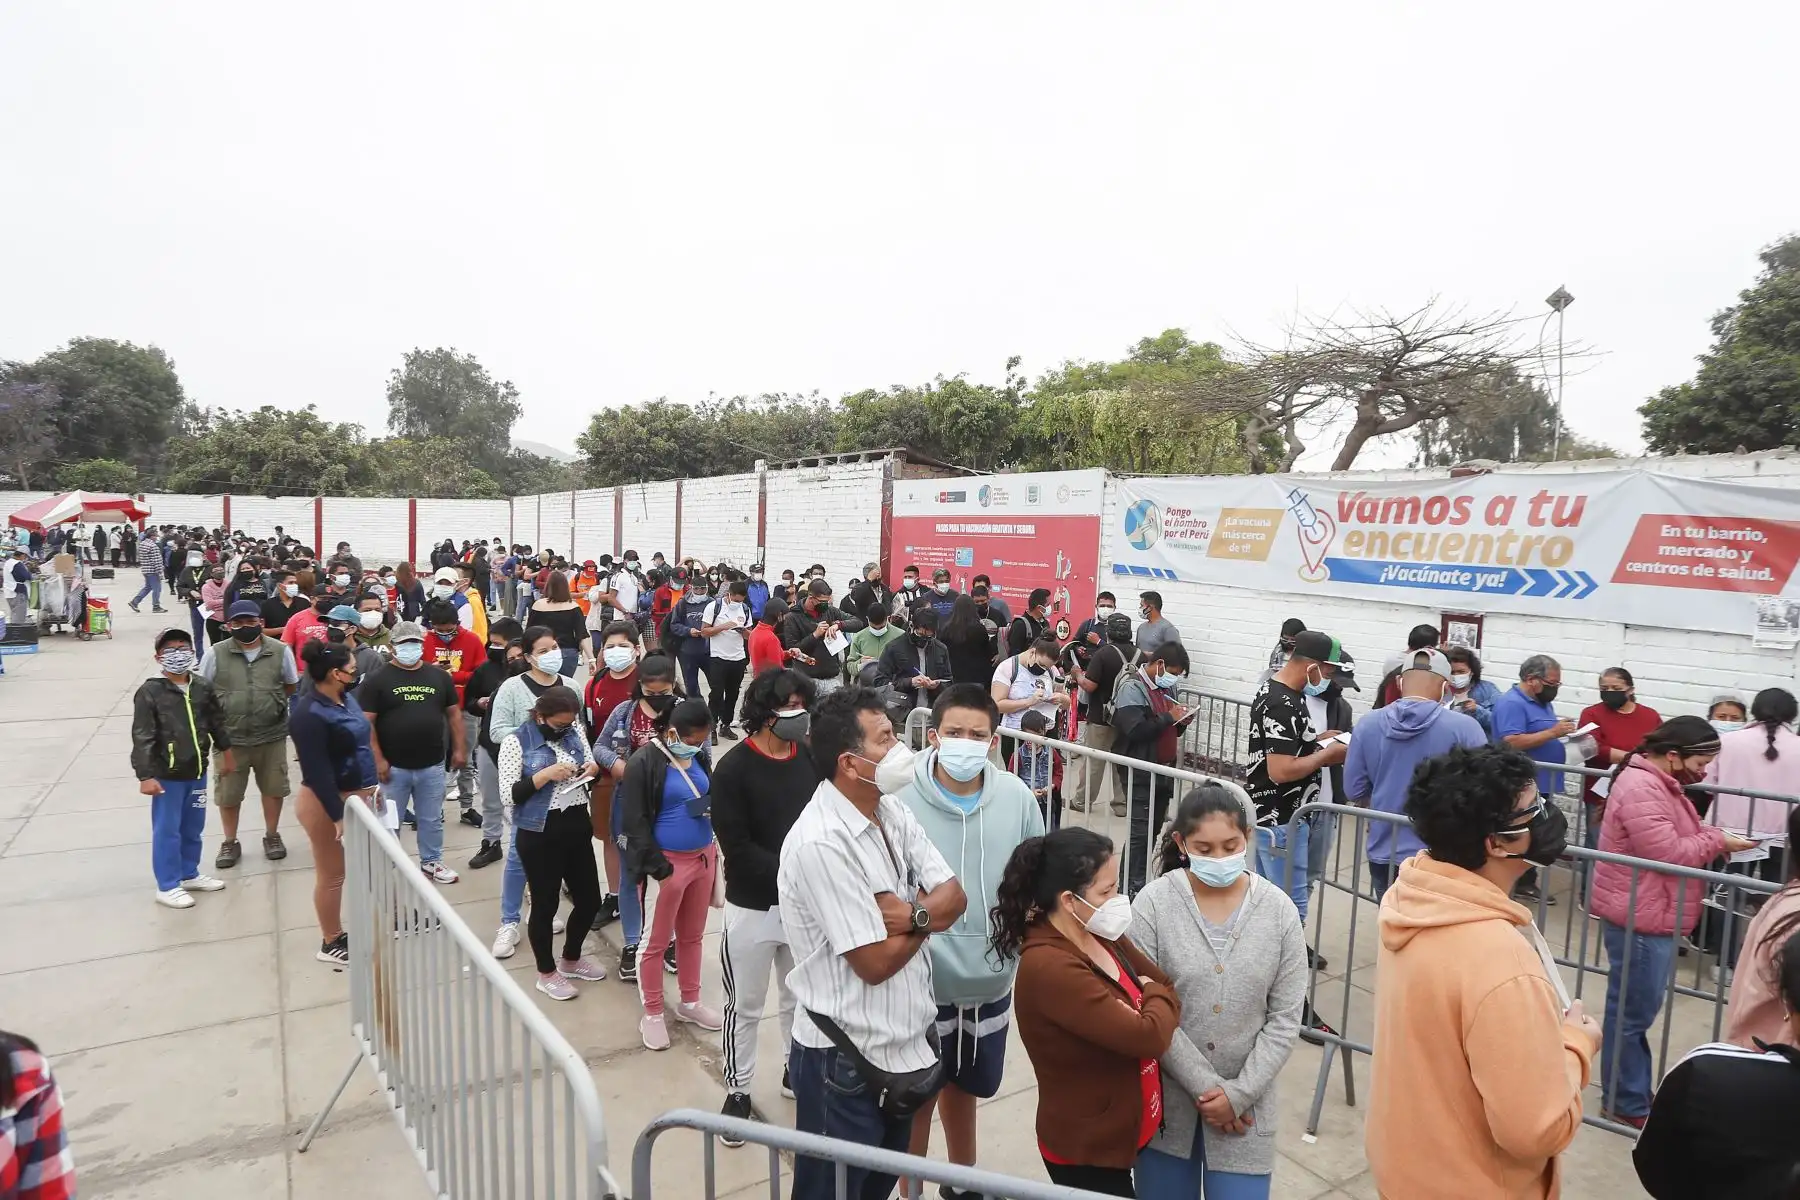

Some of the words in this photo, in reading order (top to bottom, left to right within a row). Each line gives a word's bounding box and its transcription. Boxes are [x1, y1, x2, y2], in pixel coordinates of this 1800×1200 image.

[1166, 507, 1191, 519] Pongo
[1337, 490, 1475, 526] Vamos
[1484, 495, 1518, 527] a
[1527, 489, 1588, 528] tu
[1164, 518, 1172, 527] el
[1173, 518, 1207, 528] hombro
[1239, 518, 1271, 527] vacuna
[1164, 530, 1178, 540] por
[1180, 530, 1188, 538] el
[1189, 529, 1210, 540] Perú
[1222, 529, 1240, 539] más
[1242, 532, 1266, 541] cerca
[1660, 524, 1681, 537] En
[1684, 526, 1705, 538] tu
[1707, 526, 1768, 544] barrio,
[1229, 543, 1239, 553] de
[1242, 543, 1251, 553] ti!
[1343, 528, 1575, 568] encuentro
[1658, 544, 1737, 560] mercado
[1740, 549, 1754, 564] y
[1626, 561, 1689, 576] centros
[1692, 563, 1714, 577] de
[1717, 566, 1775, 581] salud.
[1380, 564, 1470, 585] ¡Vacúnate
[1472, 571, 1507, 591] ya!
[392, 685, 436, 695] STRONGER
[404, 693, 425, 701] DAYS
